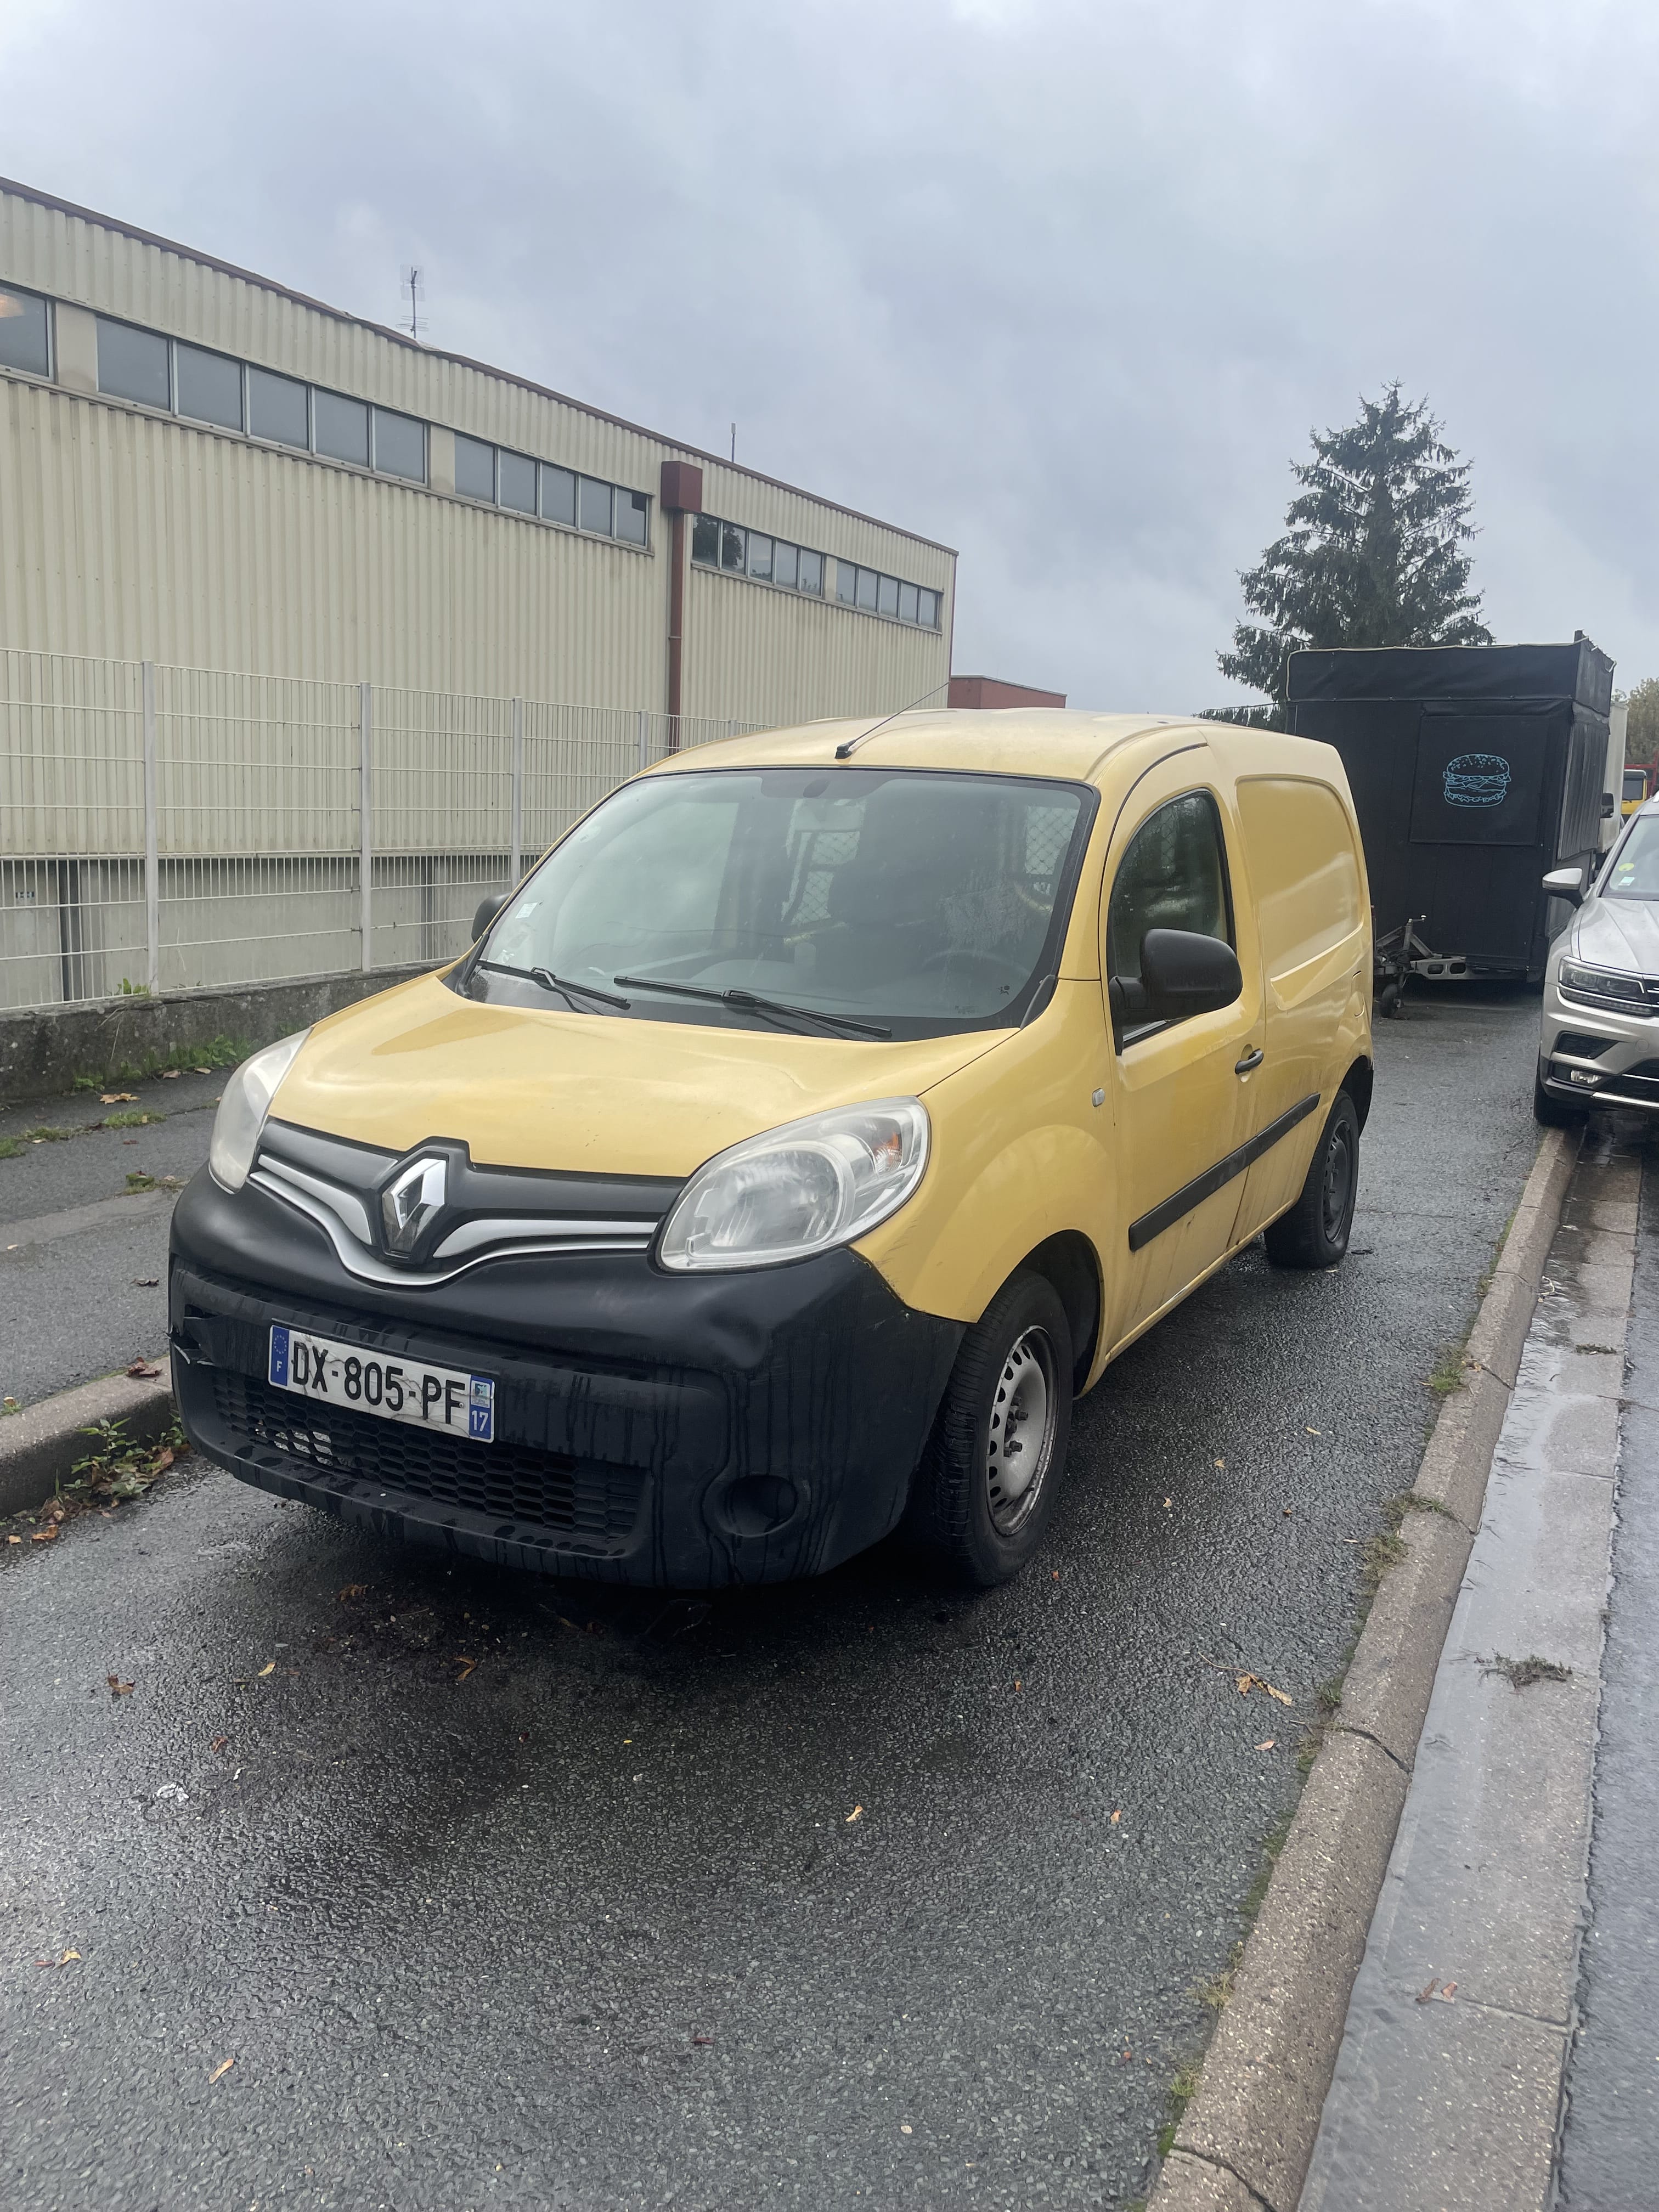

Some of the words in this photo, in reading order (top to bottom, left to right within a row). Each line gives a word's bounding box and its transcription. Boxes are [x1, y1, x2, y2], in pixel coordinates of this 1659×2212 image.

[276, 1360, 283, 1372] F
[292, 1341, 465, 1425] DX-805-PF
[471, 1410, 489, 1432] 17
